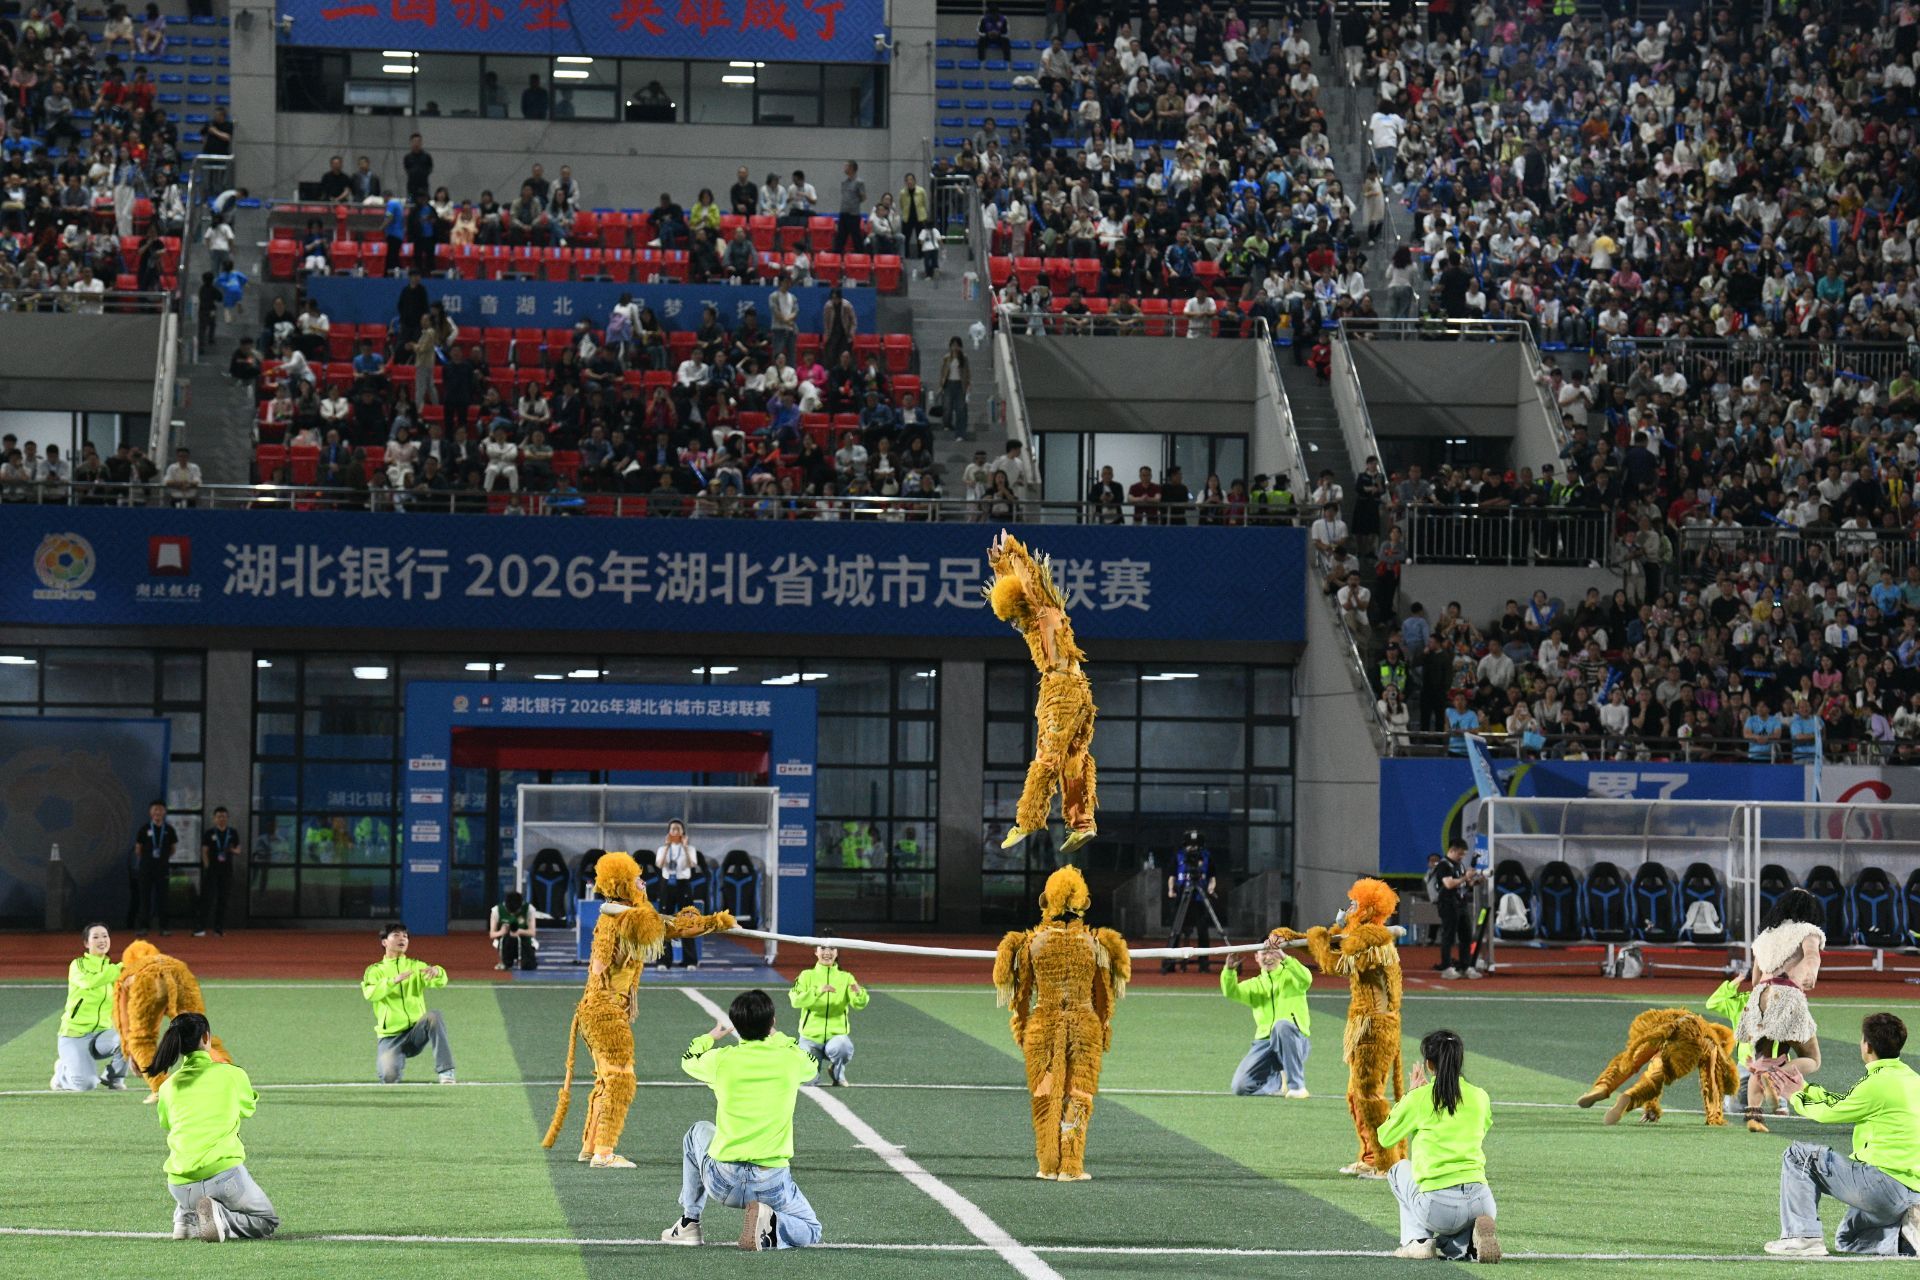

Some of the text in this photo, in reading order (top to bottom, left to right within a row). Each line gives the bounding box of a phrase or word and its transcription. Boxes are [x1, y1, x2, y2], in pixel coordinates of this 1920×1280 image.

[223, 543, 1152, 612] 湖北银行 2026年湖北省城市足联赛
[501, 697, 771, 717] 湖北银行 2026年湖北省城市足球联赛
